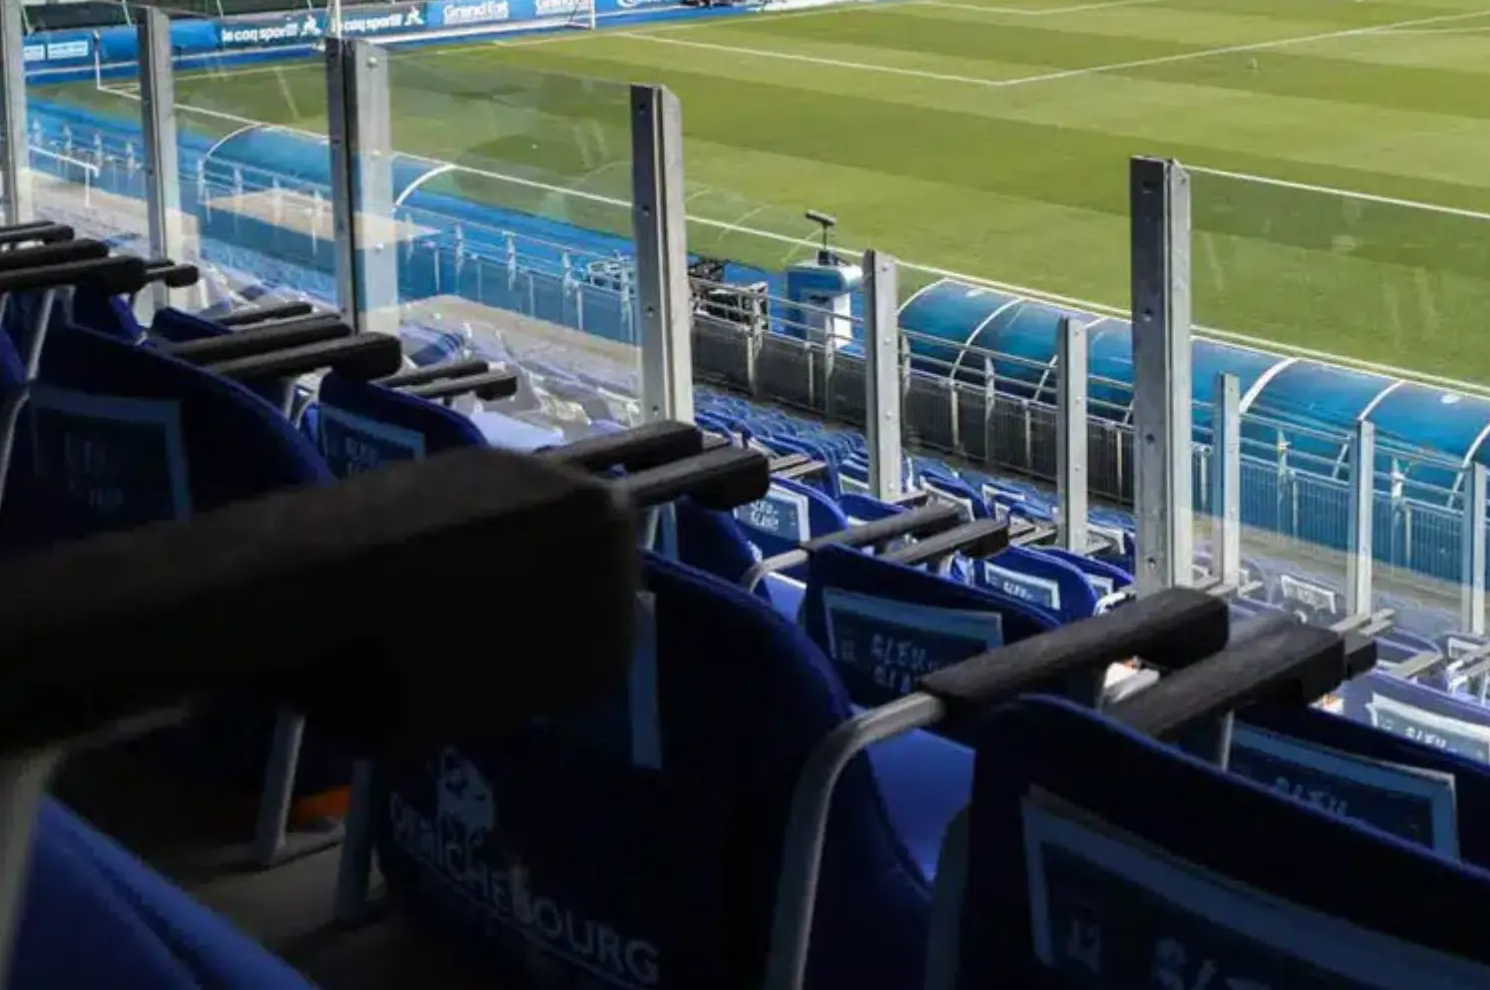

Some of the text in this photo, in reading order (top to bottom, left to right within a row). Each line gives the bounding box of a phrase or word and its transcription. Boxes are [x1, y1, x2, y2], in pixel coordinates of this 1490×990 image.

[222, 22, 298, 43] le coq sportif
